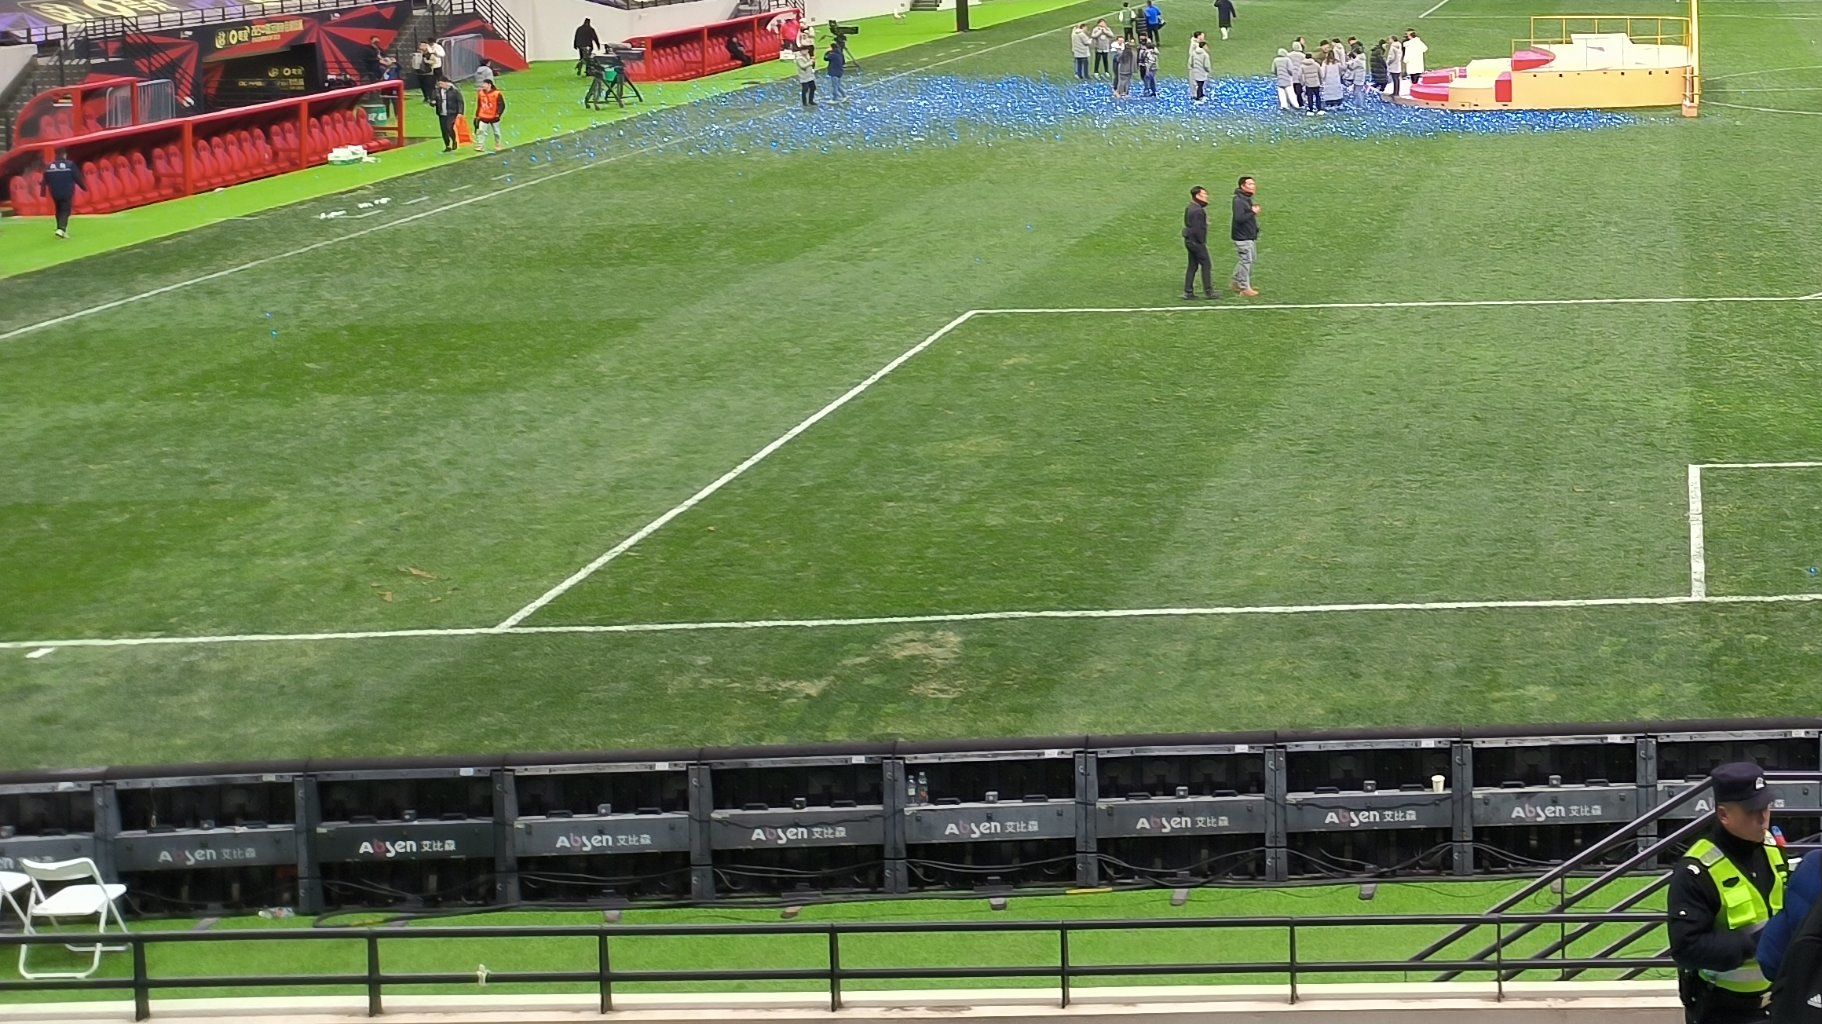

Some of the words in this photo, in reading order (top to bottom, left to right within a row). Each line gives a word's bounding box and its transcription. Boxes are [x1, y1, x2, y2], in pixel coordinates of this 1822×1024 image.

[1325, 808, 1380, 827] Absen
[1511, 803, 1566, 822] Absen
[944, 821, 1001, 838] Absen
[1136, 815, 1191, 833] Absen
[556, 833, 613, 851] Absen
[751, 825, 808, 844] Absen
[359, 839, 417, 858] Absen
